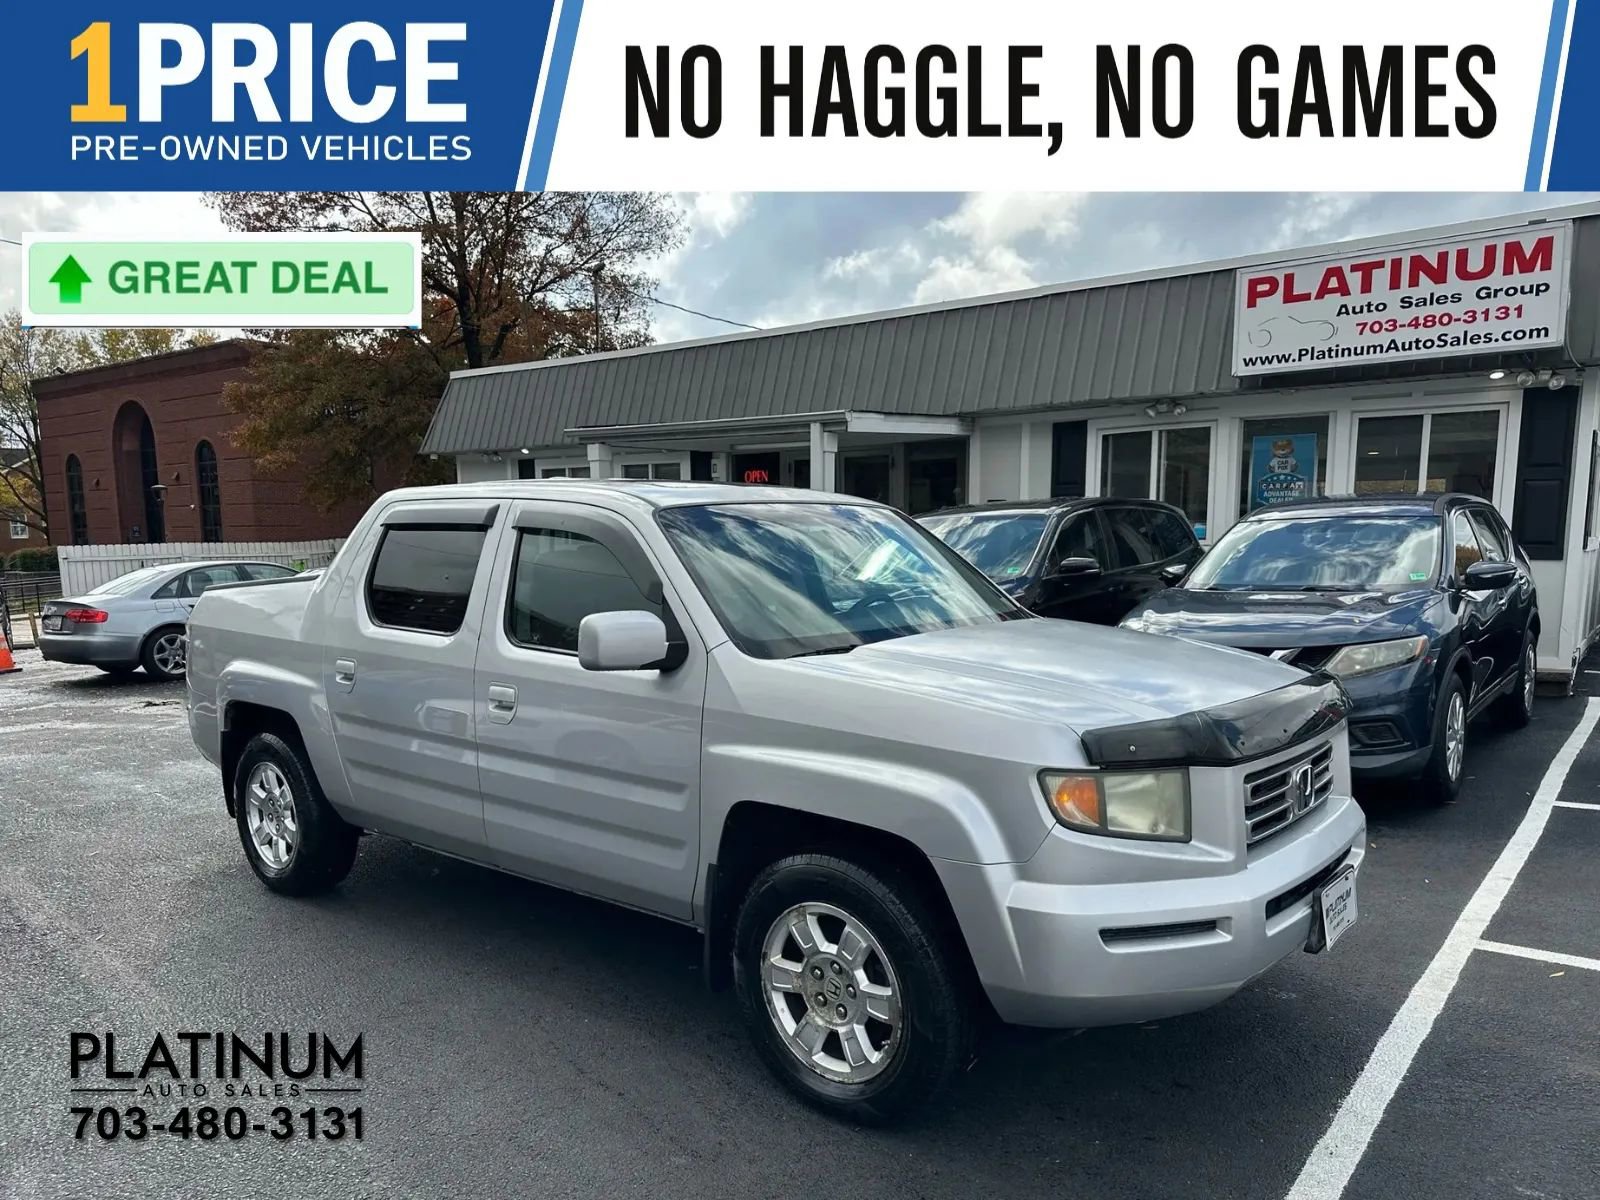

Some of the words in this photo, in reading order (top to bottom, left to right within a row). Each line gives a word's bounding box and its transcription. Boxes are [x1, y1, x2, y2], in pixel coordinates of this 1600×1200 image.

[1246, 235, 1554, 309] PLATINUM
[1336, 300, 1388, 317] Auto
[1399, 289, 1462, 310] Sales
[1475, 280, 1550, 301] Group
[1355, 304, 1524, 336] 703-480-3131
[1242, 324, 1549, 368] www.PlatinumAutoSales.com
[744, 469, 769, 483] OPEN
